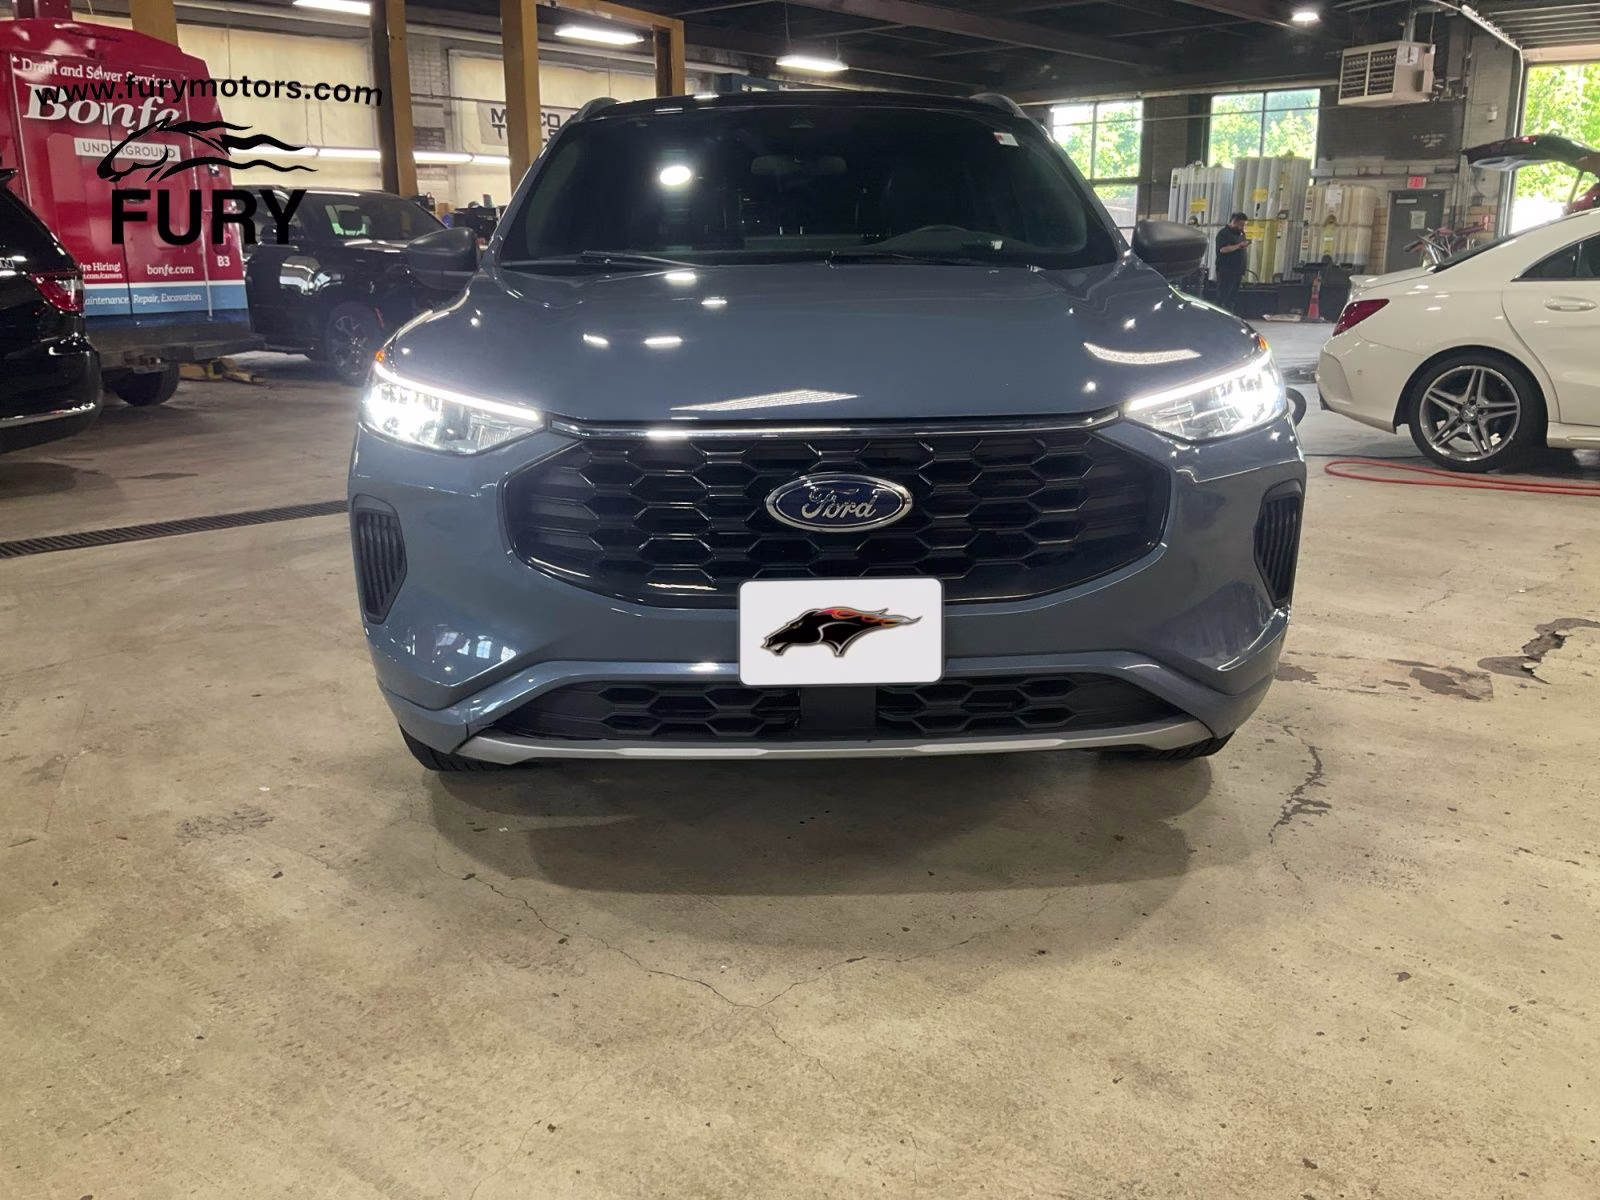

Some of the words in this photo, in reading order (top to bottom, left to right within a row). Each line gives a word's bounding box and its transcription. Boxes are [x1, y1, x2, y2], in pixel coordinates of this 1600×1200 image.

[60, 64, 83, 79] and
[86, 65, 123, 83] Sewer
[125, 71, 173, 89] Servics
[22, 82, 181, 135] Bonfe
[82, 142, 177, 160] UNDRGROUND
[146, 264, 195, 277] bonfe.com
[216, 255, 231, 268] B3
[84, 295, 130, 306] aintenance
[801, 487, 879, 519] Ford
